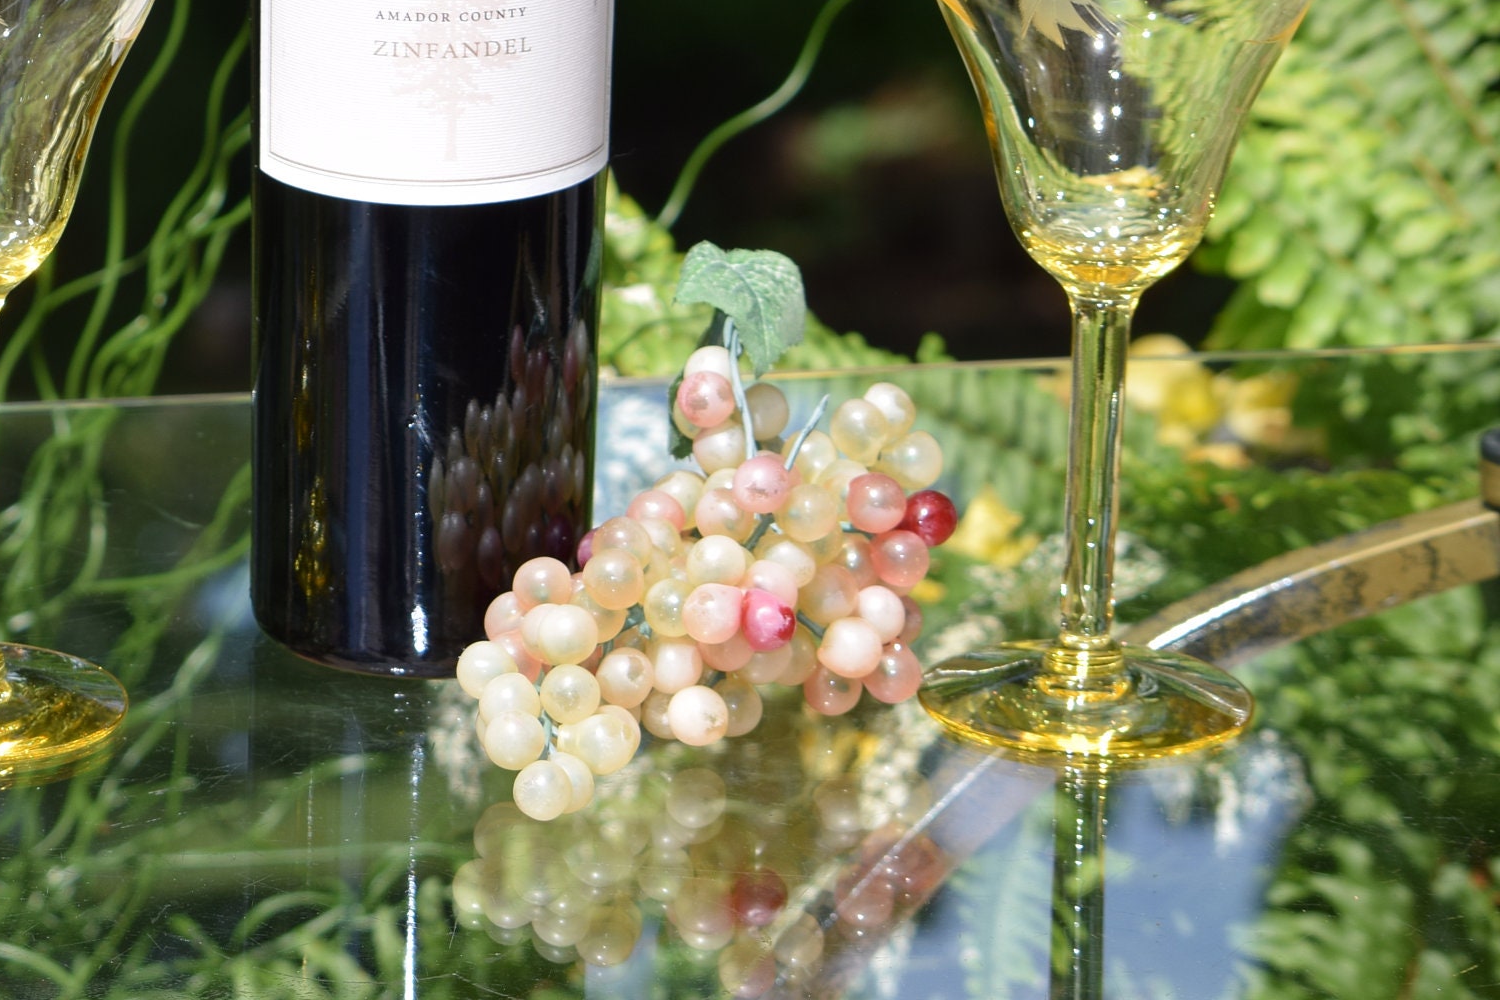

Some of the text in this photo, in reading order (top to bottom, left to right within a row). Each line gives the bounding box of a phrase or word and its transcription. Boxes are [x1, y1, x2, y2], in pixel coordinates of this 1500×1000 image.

[375, 6, 528, 23] AMADOR COUNTY
[373, 36, 532, 59] ZINFANDEL
